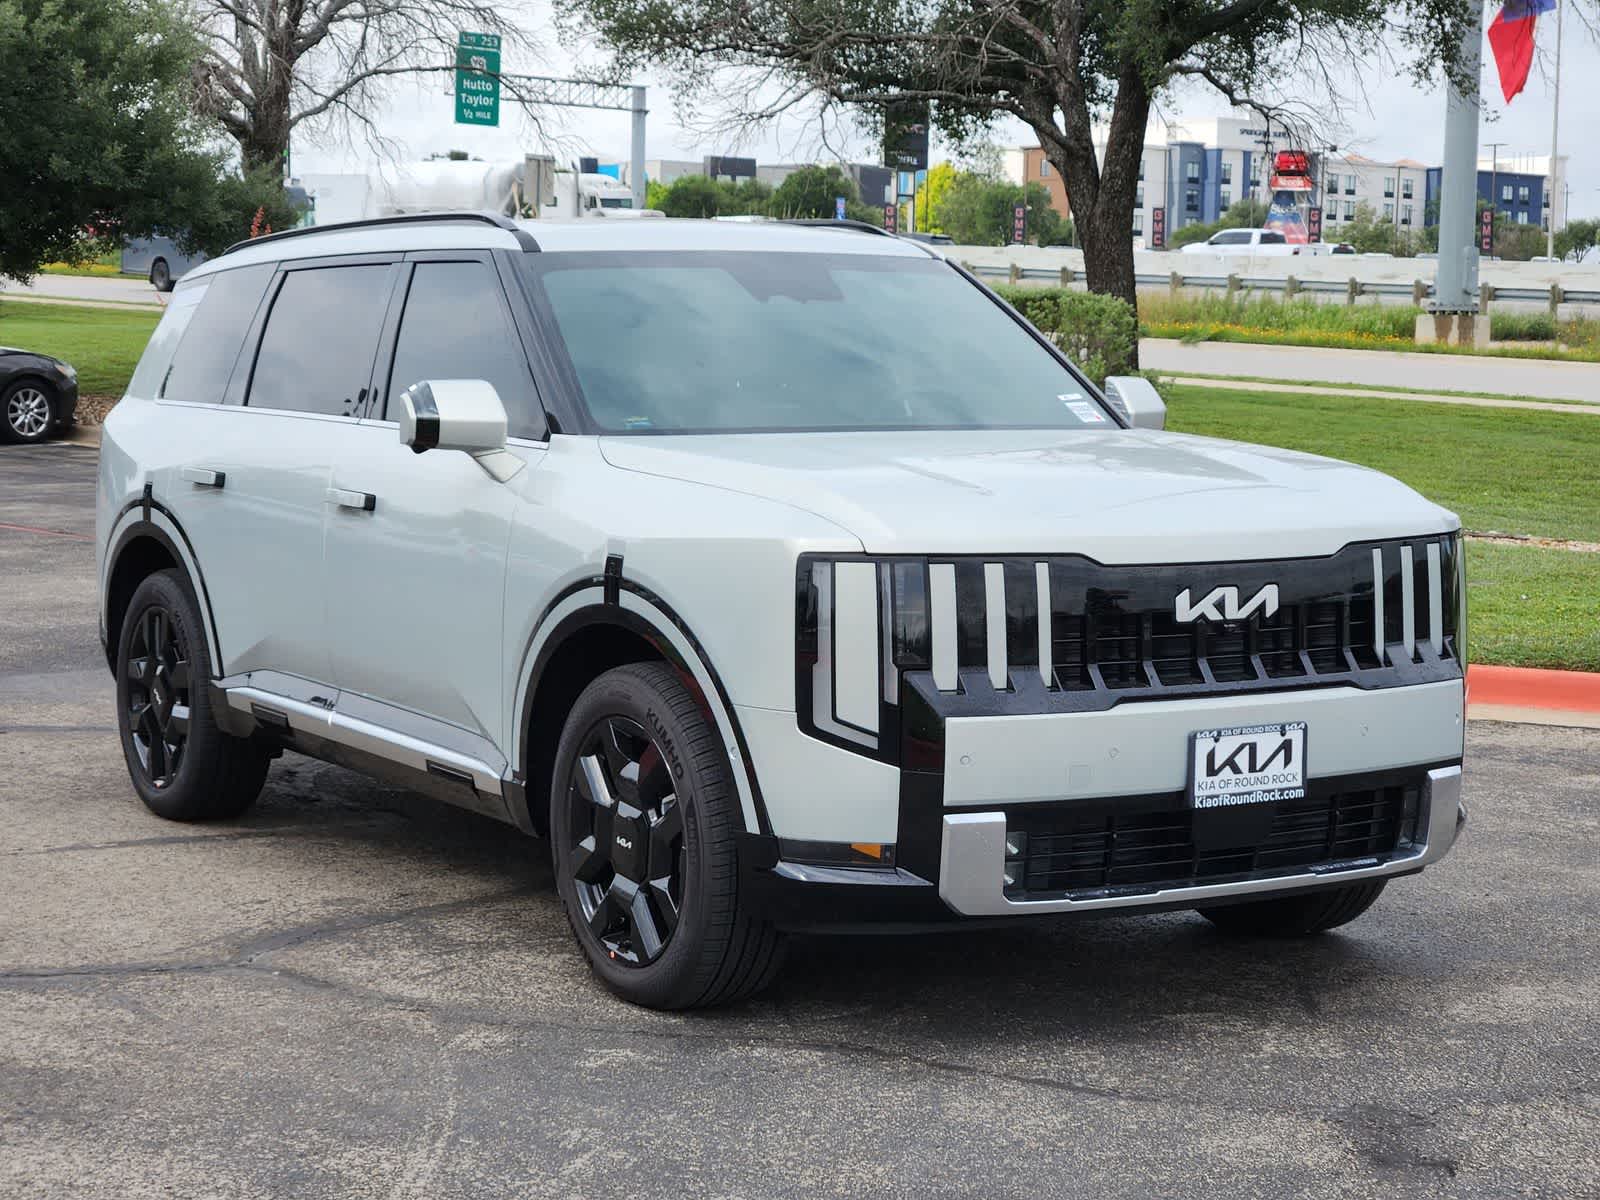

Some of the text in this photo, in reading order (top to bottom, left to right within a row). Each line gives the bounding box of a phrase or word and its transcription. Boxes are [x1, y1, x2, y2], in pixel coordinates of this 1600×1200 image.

[481, 36, 498, 46] 253
[462, 78, 493, 91] Hutto
[460, 93, 495, 107] Taylor
[475, 111, 492, 120] MILE
[1014, 207, 1024, 241] GMC
[1153, 209, 1163, 244] GMC
[1482, 210, 1492, 250] GMC
[1175, 583, 1280, 623] KIA
[1197, 722, 1306, 739] KIA KIA OF ROUND ROCK KIA
[646, 707, 685, 781] KUMHO
[1206, 738, 1293, 777] KIA
[1197, 772, 1298, 792] KIA OF ROUND ROCK
[1194, 788, 1305, 808] KiaofRoundRock.com
